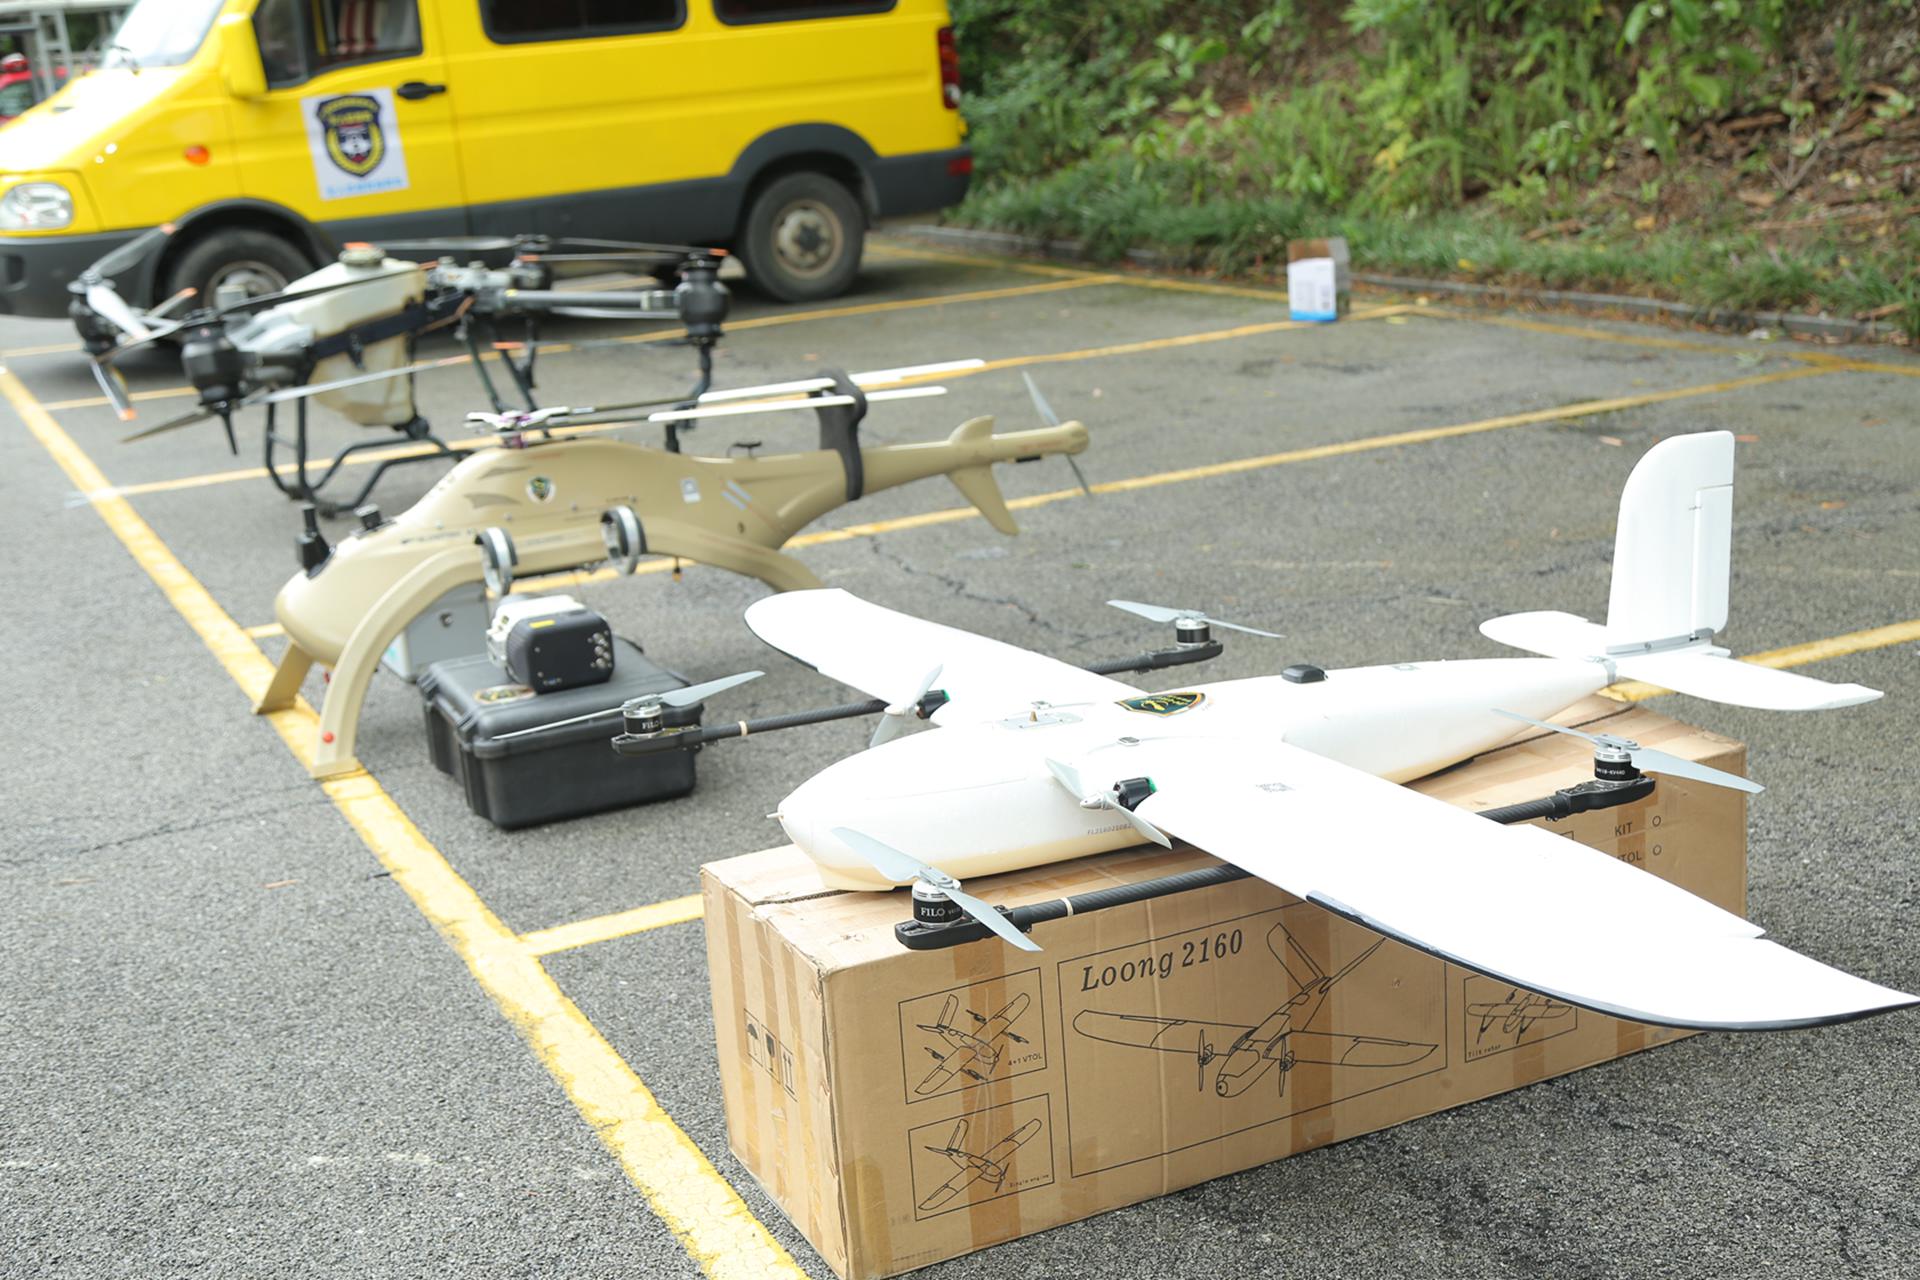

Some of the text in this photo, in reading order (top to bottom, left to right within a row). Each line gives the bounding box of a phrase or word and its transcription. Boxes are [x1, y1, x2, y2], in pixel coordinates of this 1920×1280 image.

[1615, 820, 1633, 837] KIT
[921, 907, 945, 918] FILO
[1081, 928, 1243, 992] Loong 2160
[1022, 1052, 1042, 1063] VTOL
